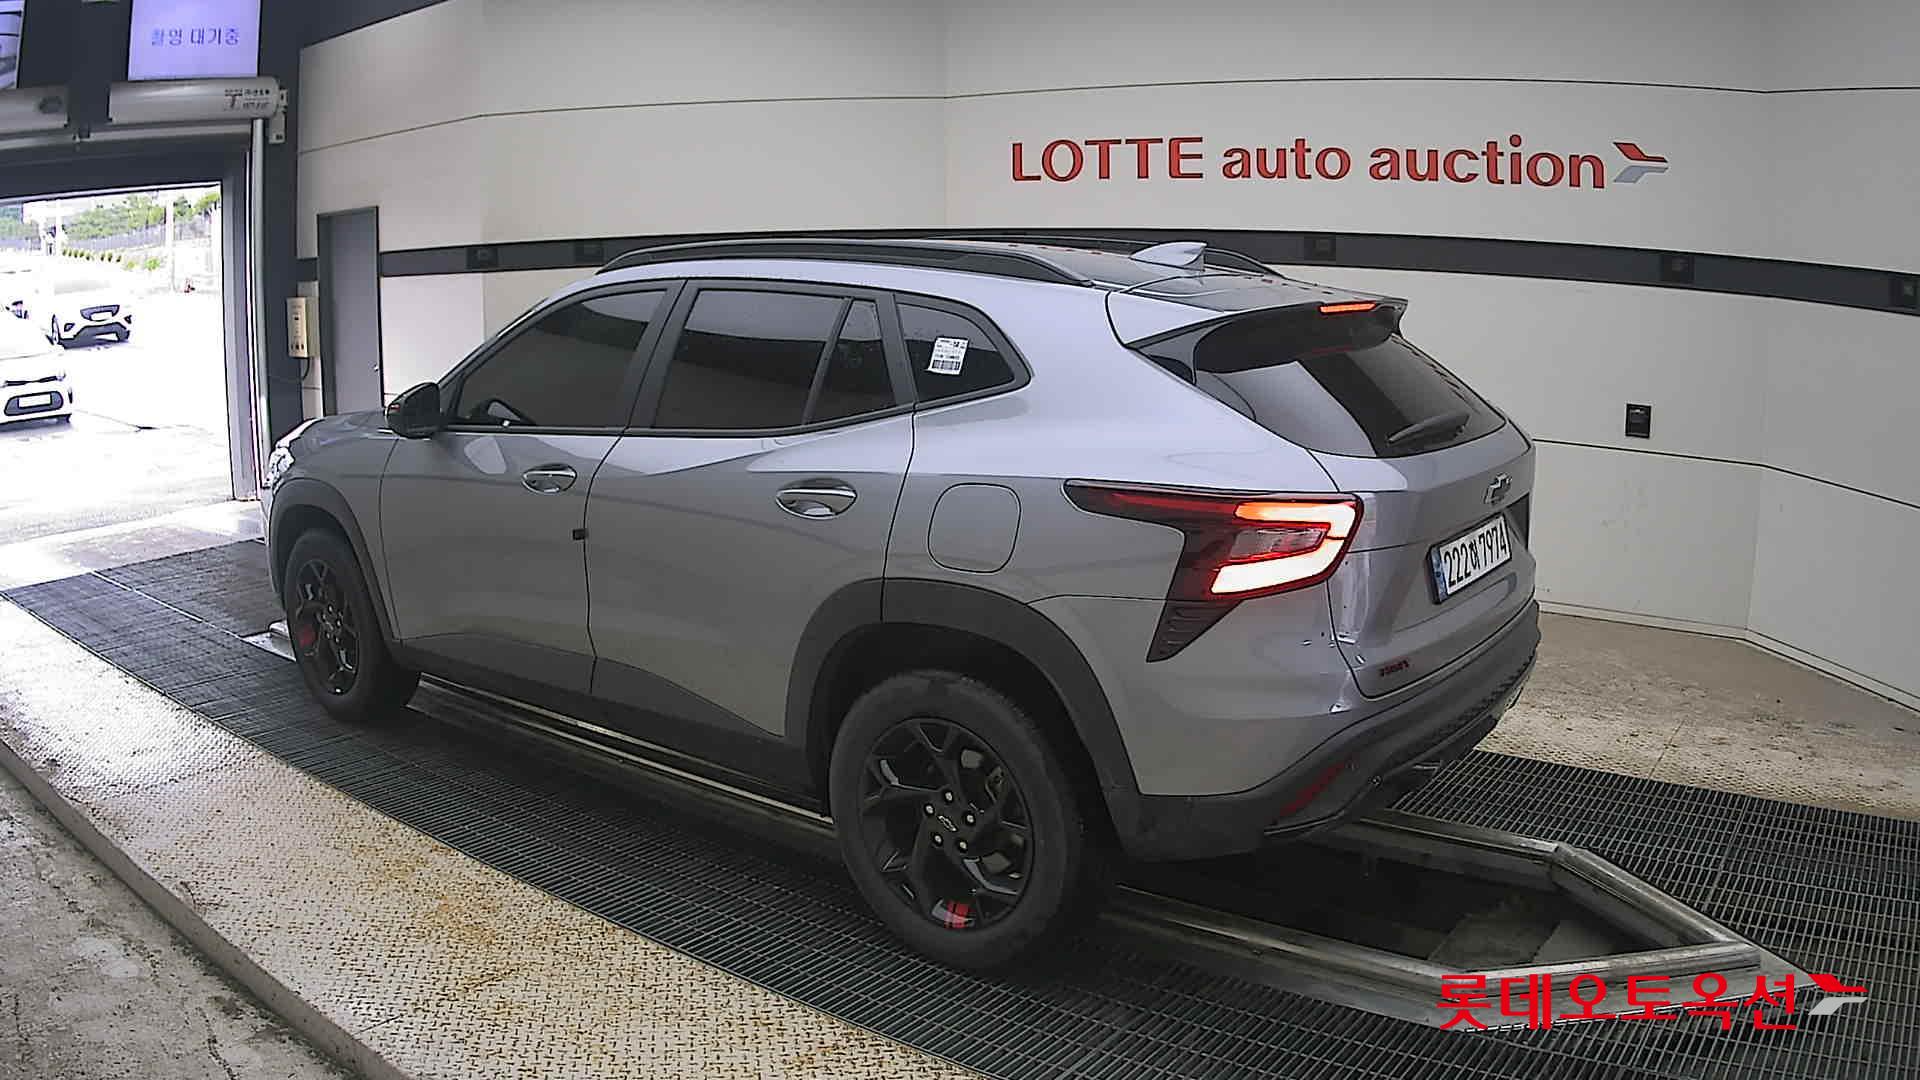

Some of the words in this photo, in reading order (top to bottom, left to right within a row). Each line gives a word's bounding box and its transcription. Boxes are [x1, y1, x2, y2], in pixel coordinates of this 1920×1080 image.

[1011, 136, 1203, 182] LOTTE
[1222, 138, 1351, 180] auto
[1369, 135, 1605, 189] auction
